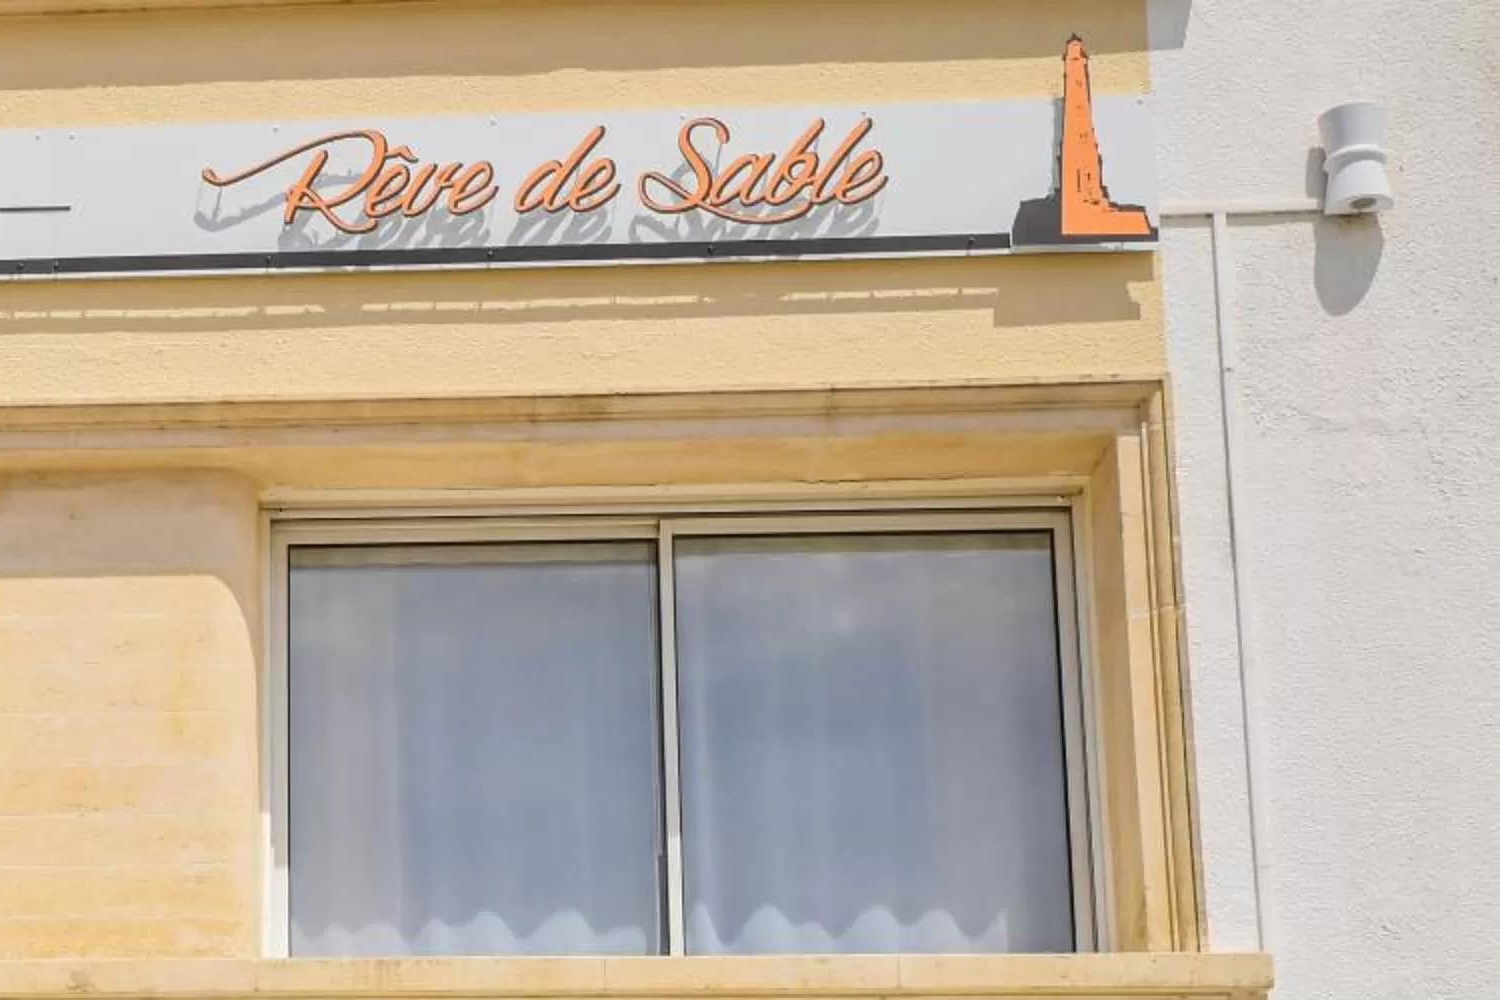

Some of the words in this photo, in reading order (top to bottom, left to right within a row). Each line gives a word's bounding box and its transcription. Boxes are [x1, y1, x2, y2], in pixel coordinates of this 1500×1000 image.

[201, 128, 500, 234] Rêve
[511, 124, 621, 217] de
[637, 115, 891, 227] Sable
